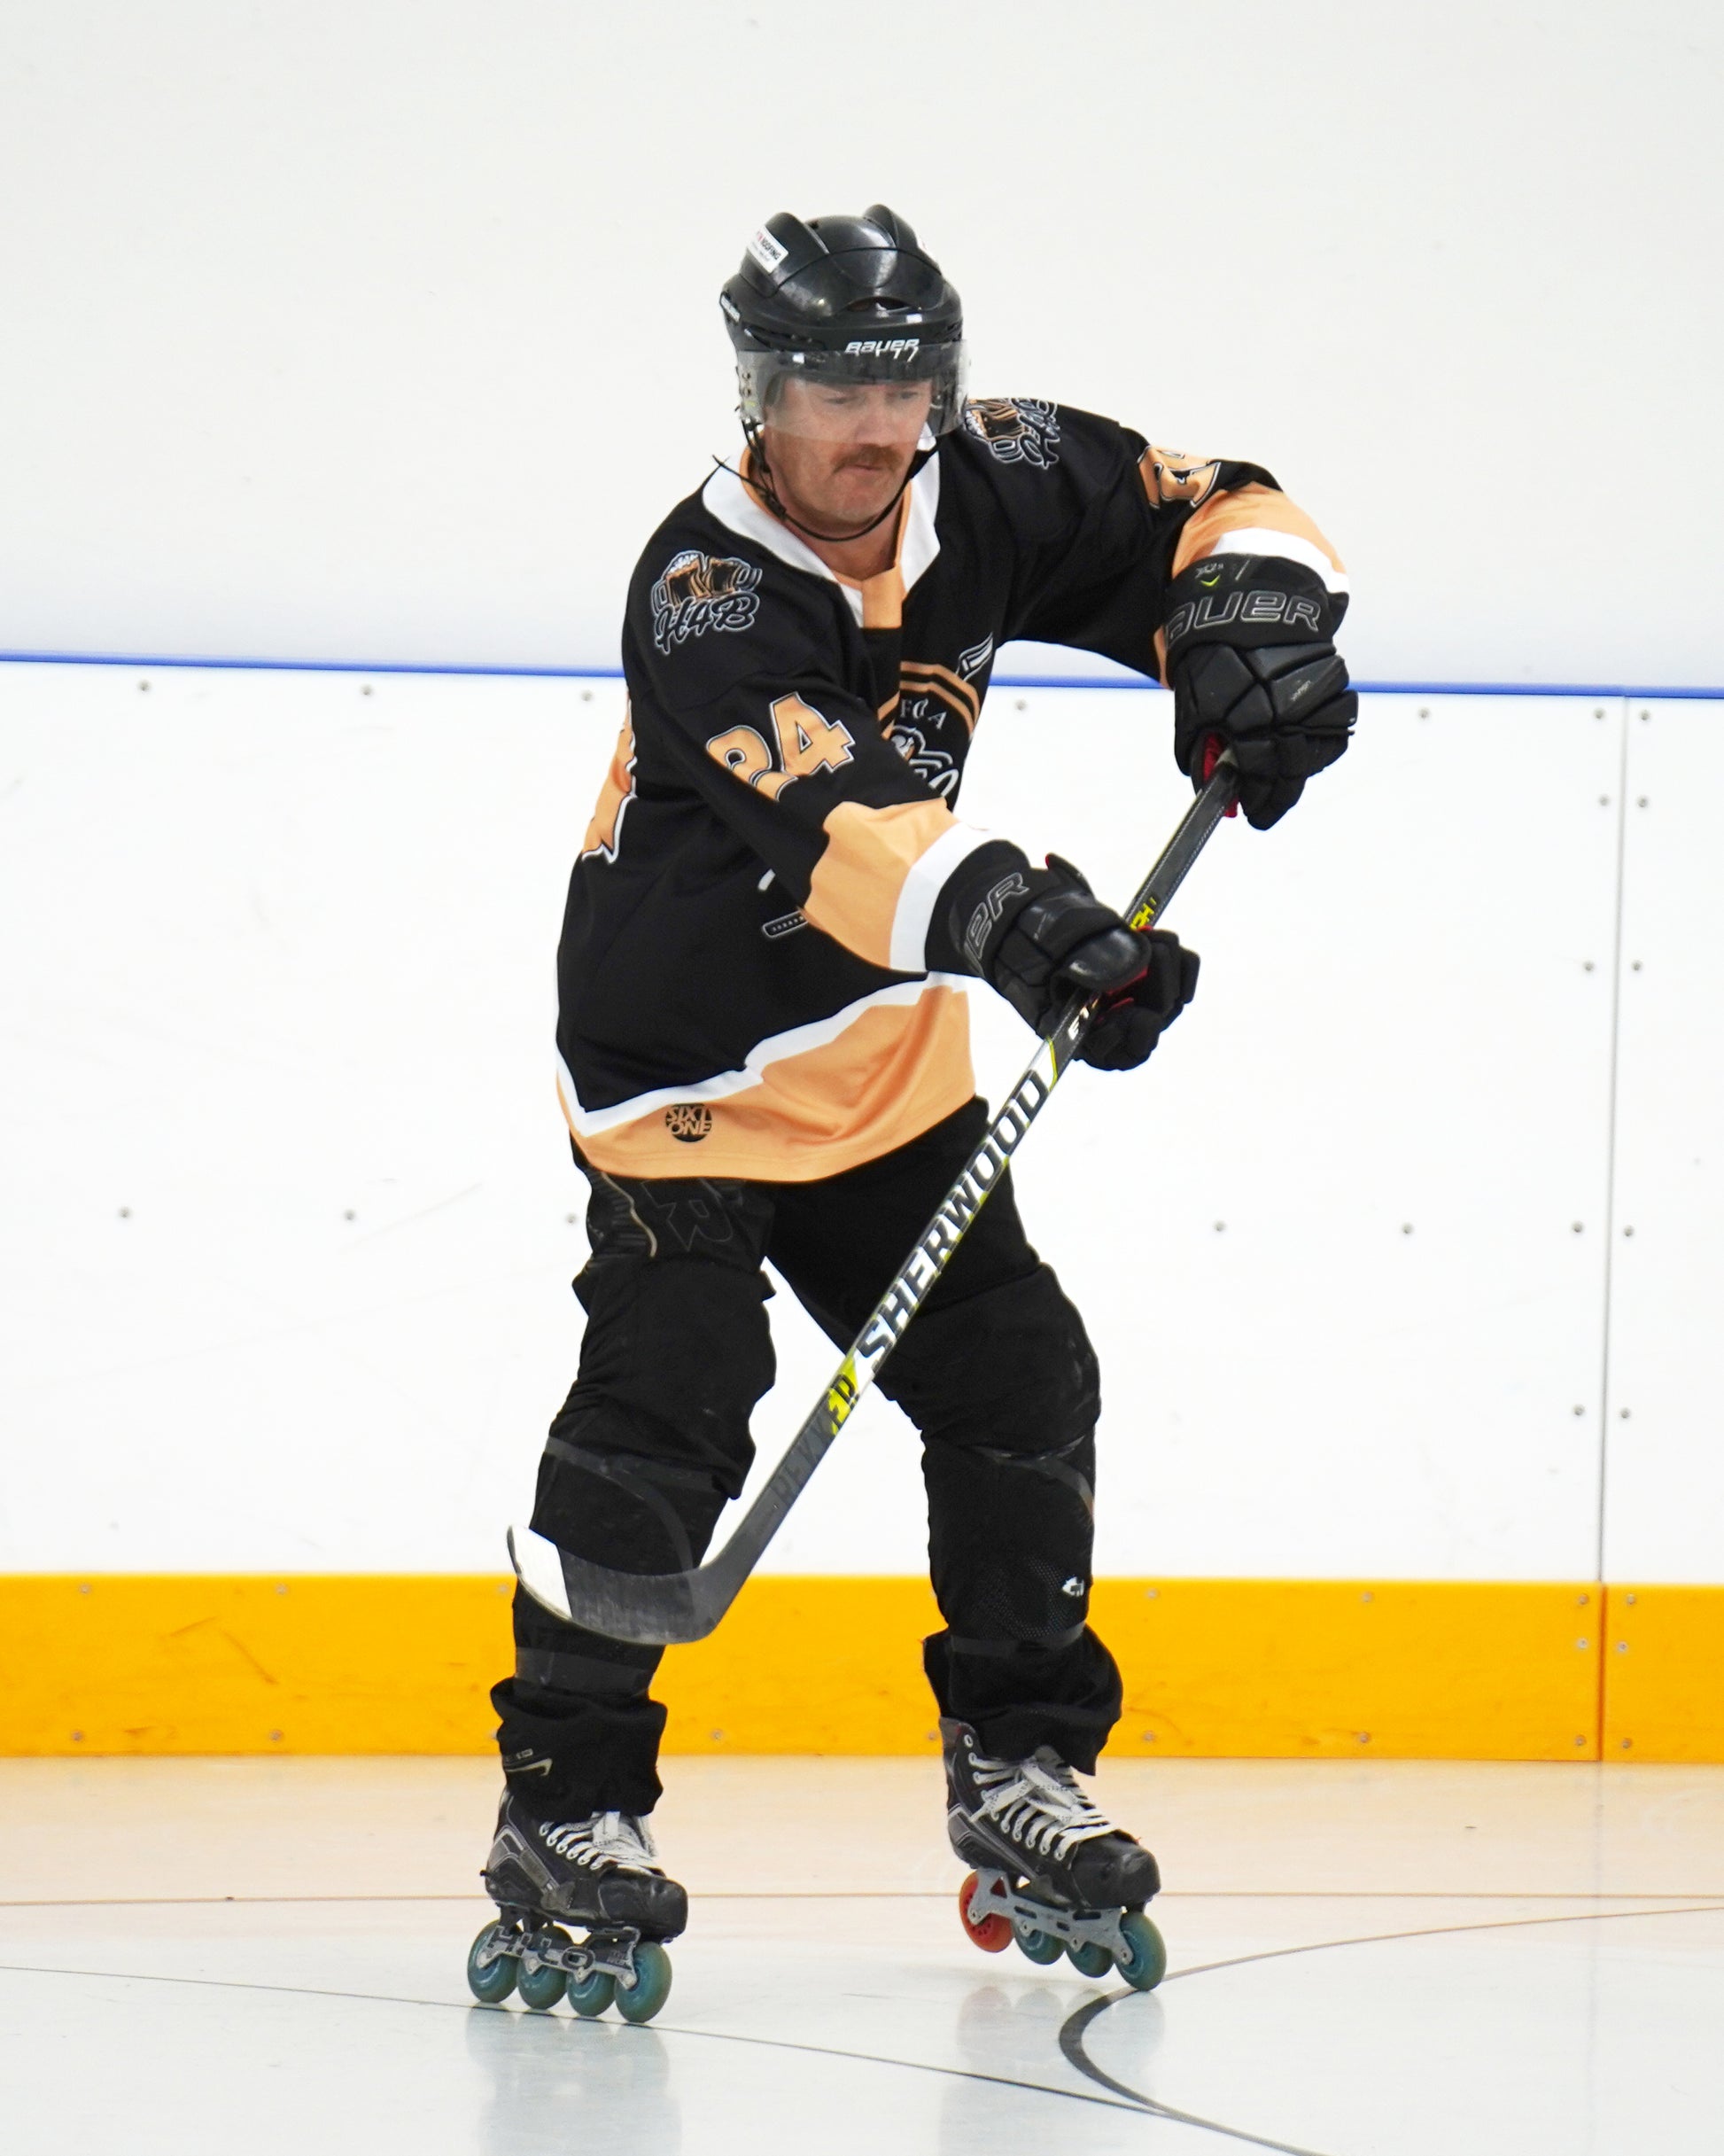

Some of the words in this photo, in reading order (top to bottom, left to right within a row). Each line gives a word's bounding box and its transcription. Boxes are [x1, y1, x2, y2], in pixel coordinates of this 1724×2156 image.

[844, 339, 920, 360] BAUER
[1166, 590, 1321, 649] AUER
[670, 1119, 712, 1135] ONE
[856, 1069, 1051, 1359] SHERWOOD
